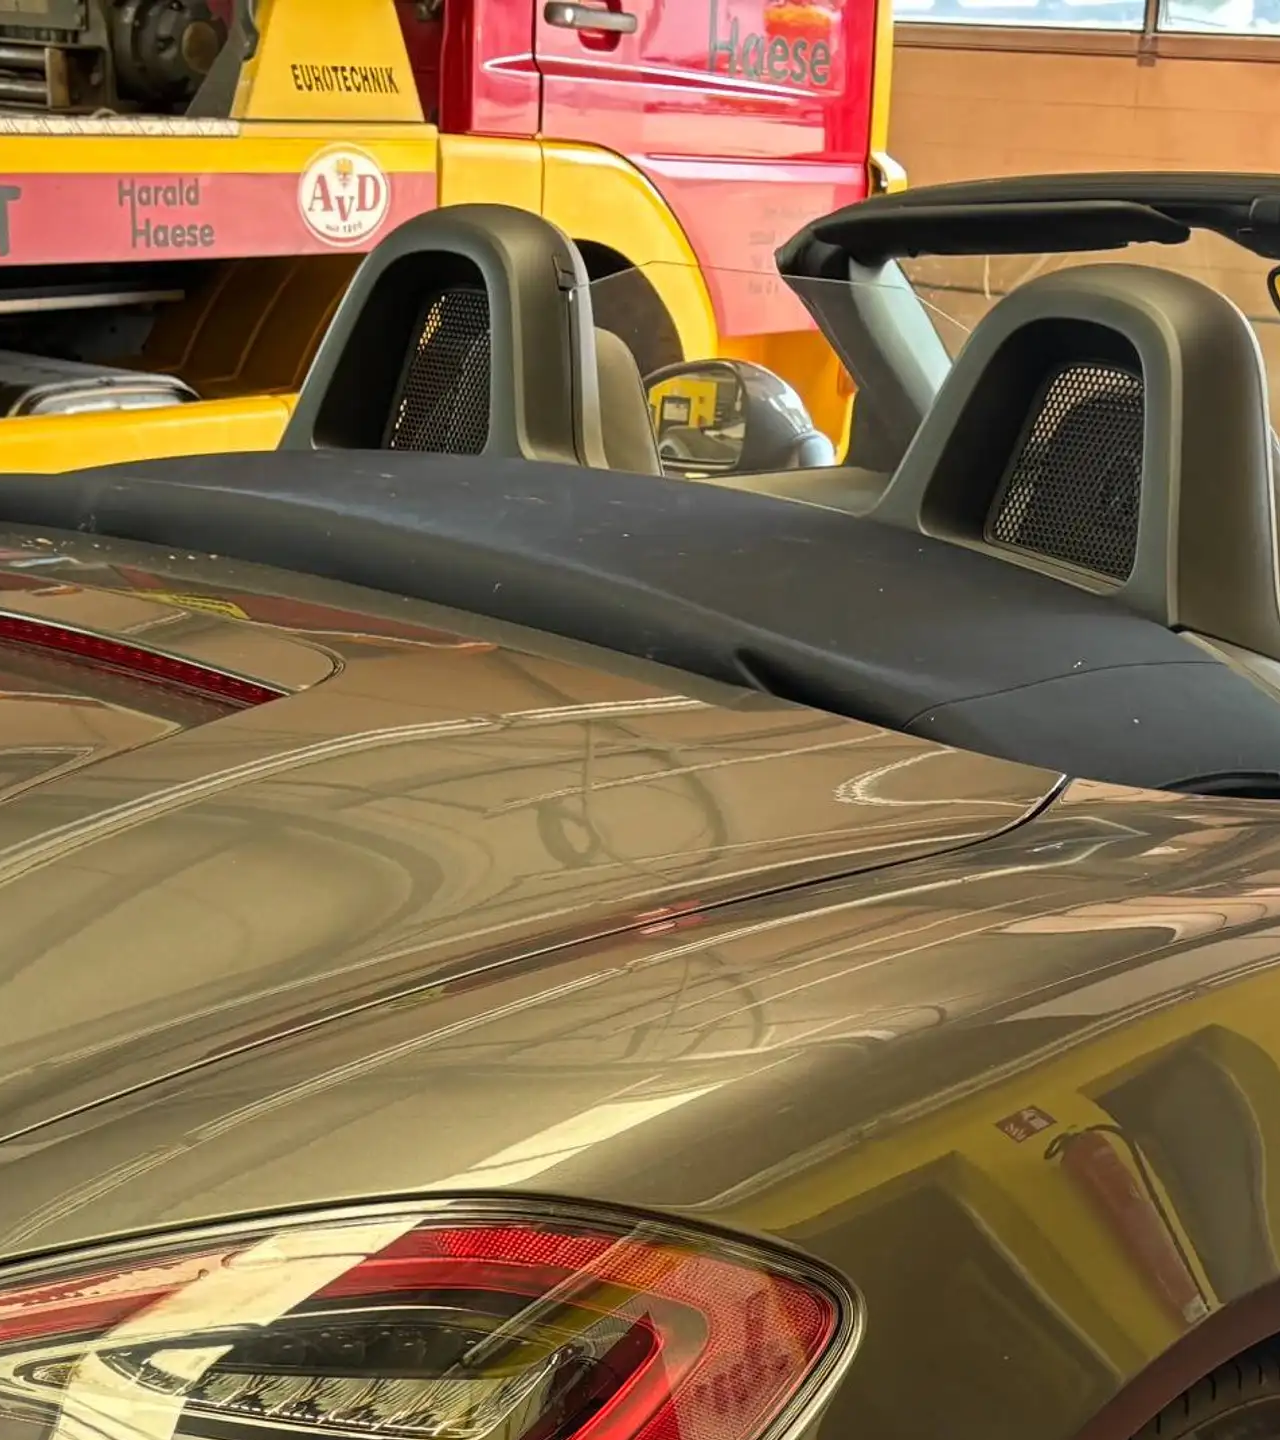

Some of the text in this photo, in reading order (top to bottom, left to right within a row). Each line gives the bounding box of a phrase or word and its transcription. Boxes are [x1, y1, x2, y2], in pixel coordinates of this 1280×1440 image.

[708, 8, 831, 85] Haese
[290, 63, 400, 94] EUROTECHNIK
[117, 177, 200, 208] Harald
[131, 216, 215, 249] Haese
